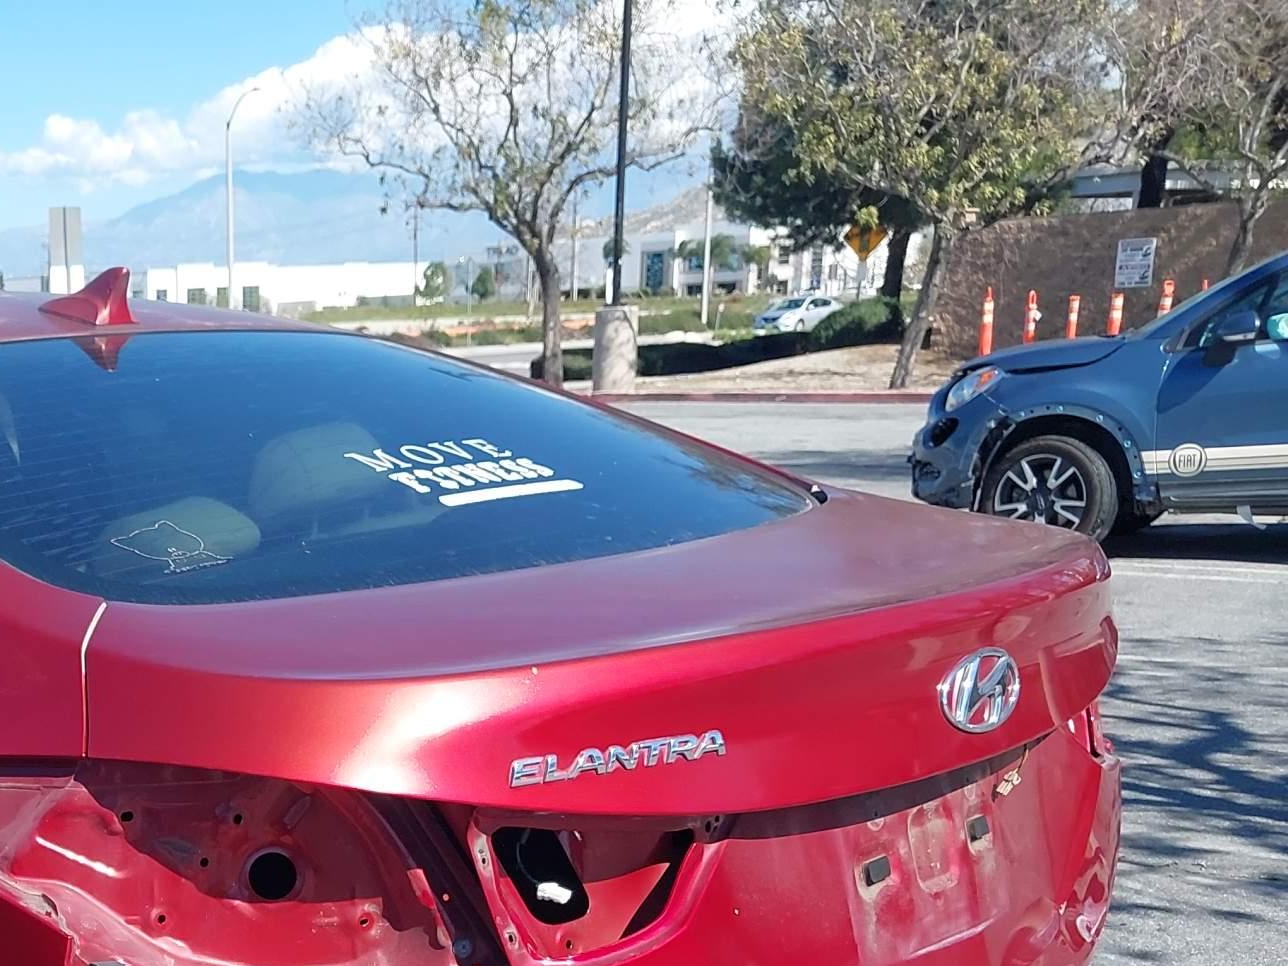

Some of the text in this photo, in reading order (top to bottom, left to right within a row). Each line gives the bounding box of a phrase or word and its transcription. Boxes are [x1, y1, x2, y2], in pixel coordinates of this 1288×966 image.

[343, 438, 512, 472] MOVE
[1178, 454, 1198, 468] FIAT
[387, 457, 555, 494] FITNESS
[509, 729, 727, 788] ELANTRA
